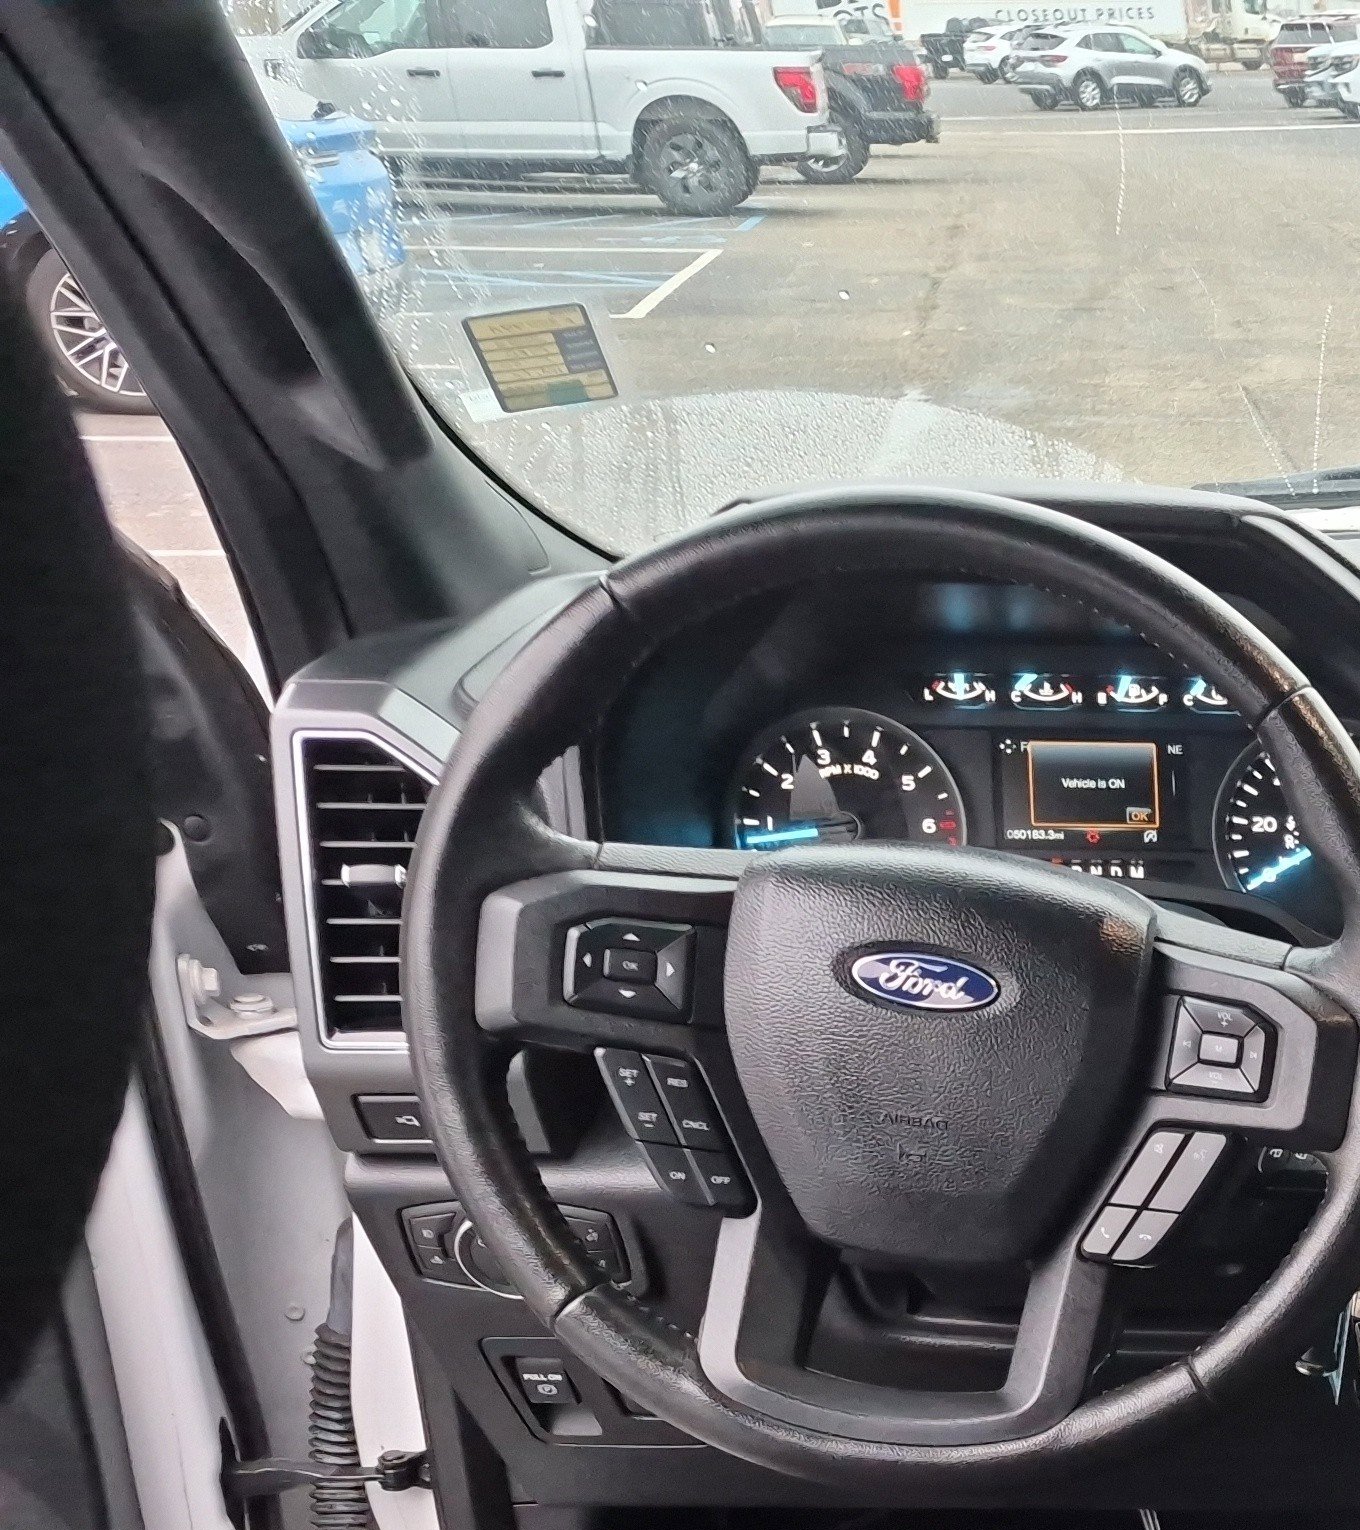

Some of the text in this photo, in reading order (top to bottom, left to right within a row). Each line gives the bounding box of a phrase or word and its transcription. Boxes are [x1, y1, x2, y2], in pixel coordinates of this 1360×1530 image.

[995, 7, 1155, 22] CLOSEOUT PRICES
[816, 750, 831, 765] 3
[862, 749, 878, 766] 4
[1167, 745, 1184, 755] NE
[780, 773, 795, 790] 2
[901, 774, 916, 791] 5
[1061, 778, 1096, 789] Vehicle
[1108, 779, 1126, 789] ON
[1130, 811, 1149, 822] OK
[1251, 816, 1278, 833] 20
[921, 818, 937, 834] 6
[878, 957, 970, 1000] Ford
